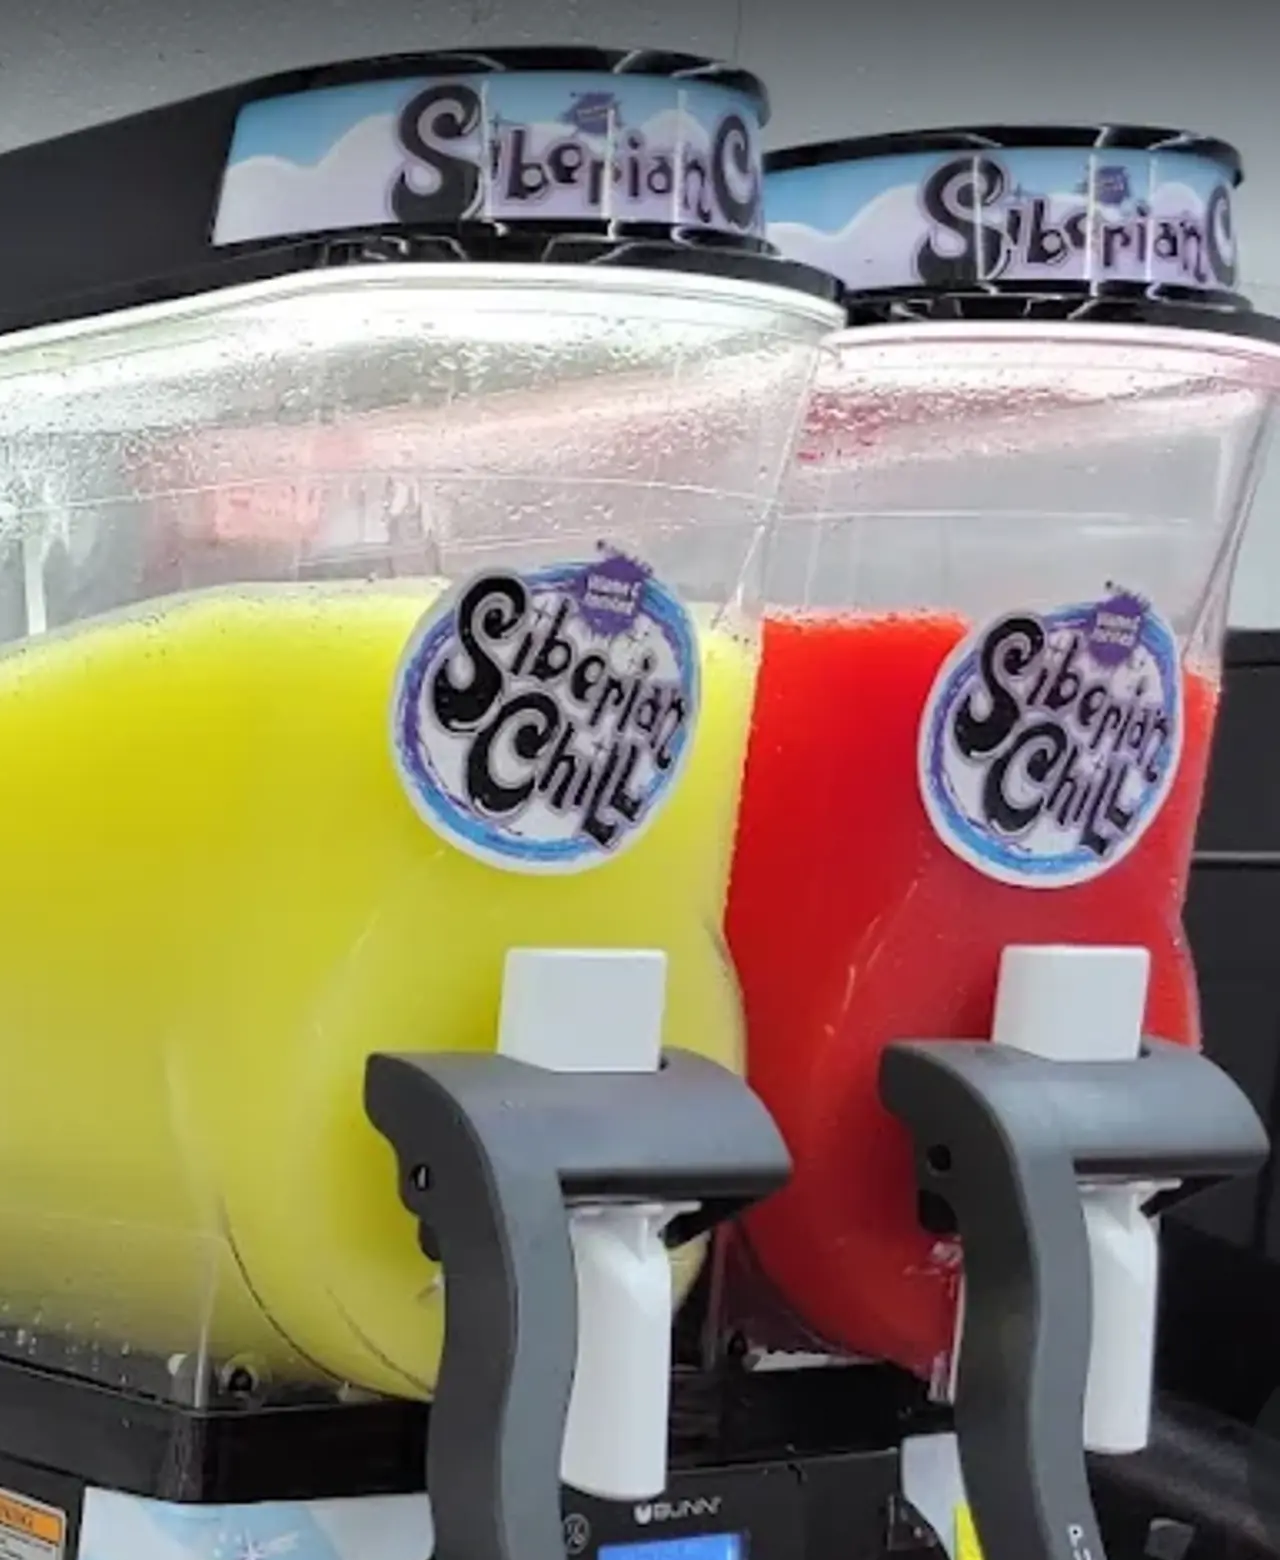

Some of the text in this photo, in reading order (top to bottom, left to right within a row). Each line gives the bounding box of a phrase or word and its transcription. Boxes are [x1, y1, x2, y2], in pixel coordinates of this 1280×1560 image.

[391, 84, 710, 223] Siberian
[917, 157, 1207, 284] Siberian
[433, 577, 685, 769] Siberian
[954, 618, 1169, 782] Siberian
